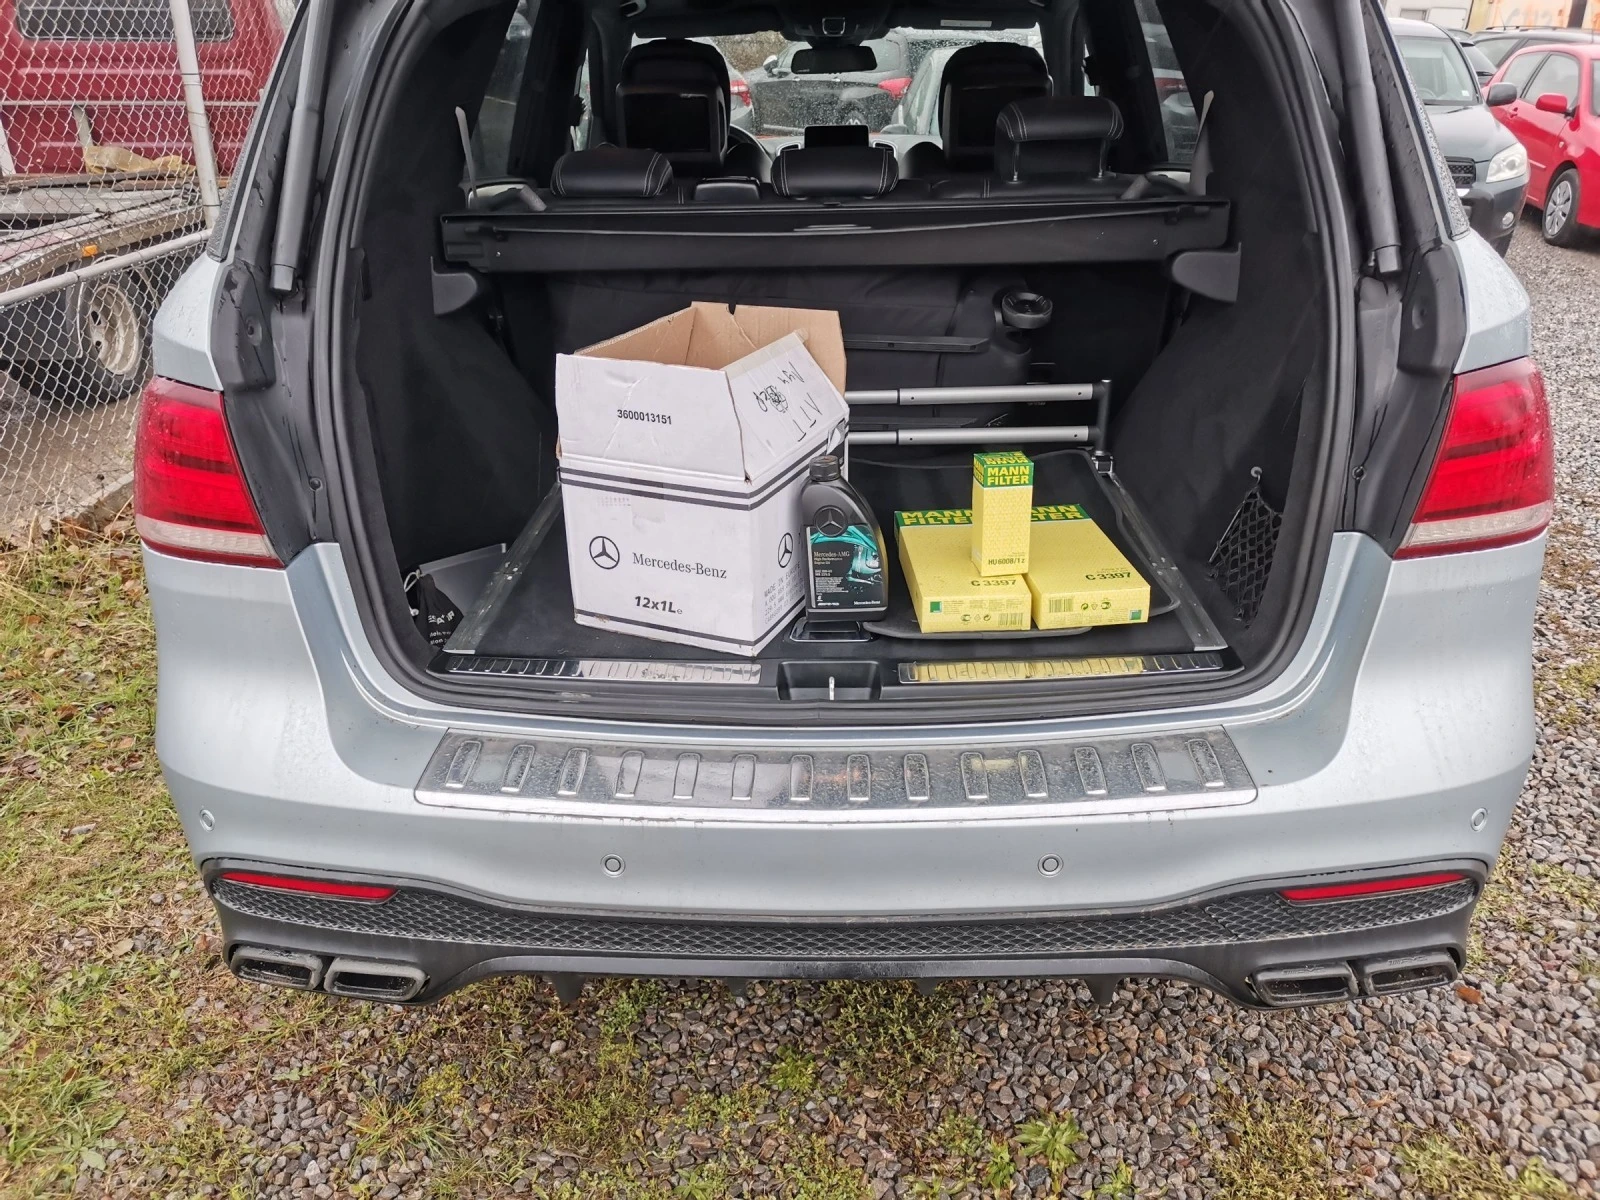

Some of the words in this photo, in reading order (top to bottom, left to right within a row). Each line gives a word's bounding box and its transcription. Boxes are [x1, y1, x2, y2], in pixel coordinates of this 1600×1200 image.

[617, 409, 672, 425] 3600013151
[987, 466, 1030, 476] MANN
[987, 475, 1030, 486] FILTER
[1031, 505, 1079, 513] NN
[904, 516, 973, 525] FILTE
[1031, 512, 1084, 520] TER
[632, 552, 727, 579] Mercedes-Benz
[1097, 571, 1131, 580] 3397
[983, 579, 1017, 587] 3397
